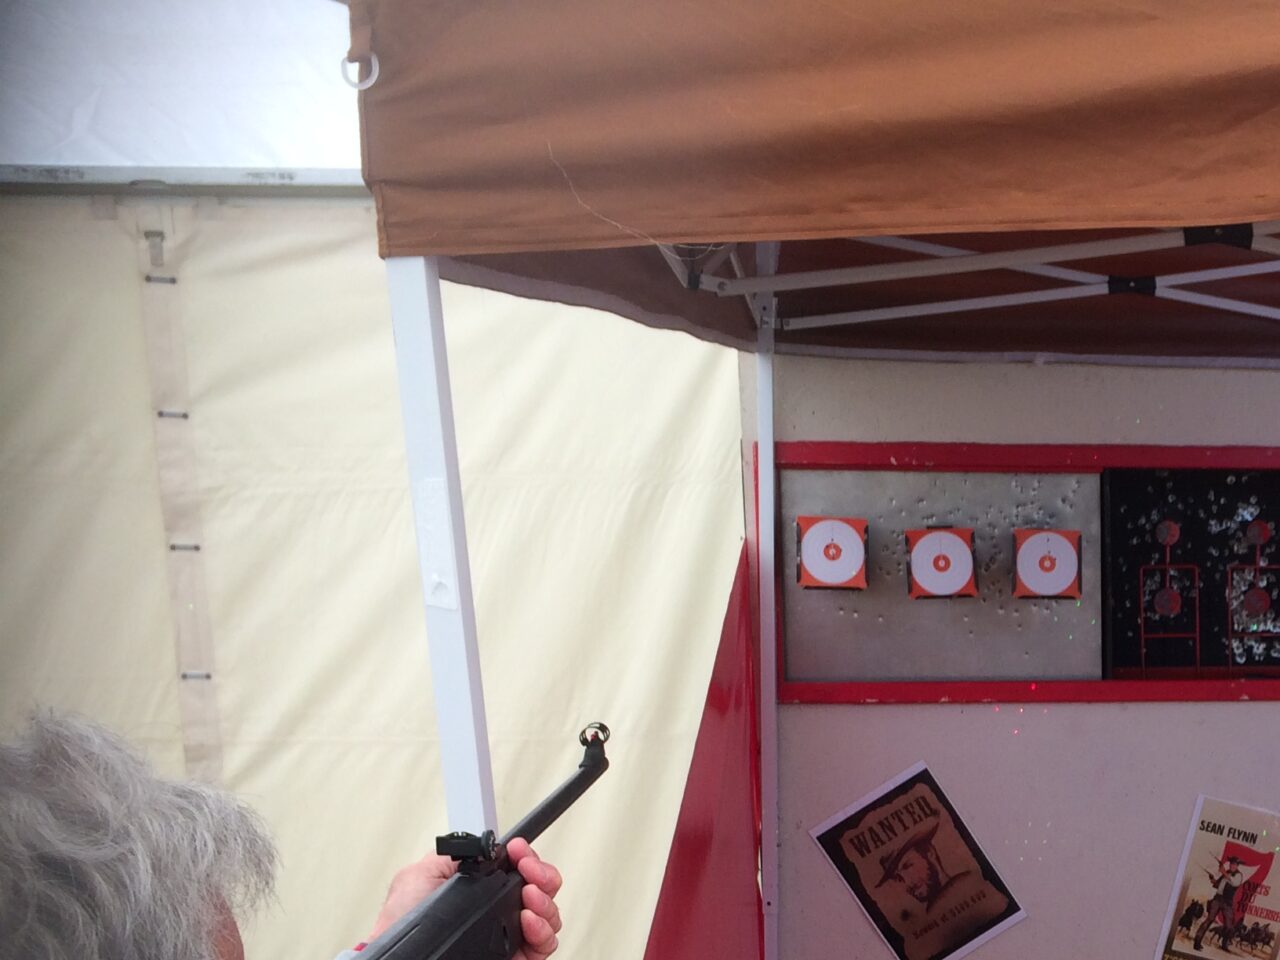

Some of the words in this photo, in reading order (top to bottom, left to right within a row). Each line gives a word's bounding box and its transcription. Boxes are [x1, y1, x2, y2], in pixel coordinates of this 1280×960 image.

[850, 796, 936, 858] WANTED
[1199, 820, 1225, 836] SEAN
[1226, 827, 1258, 844] FLYNN
